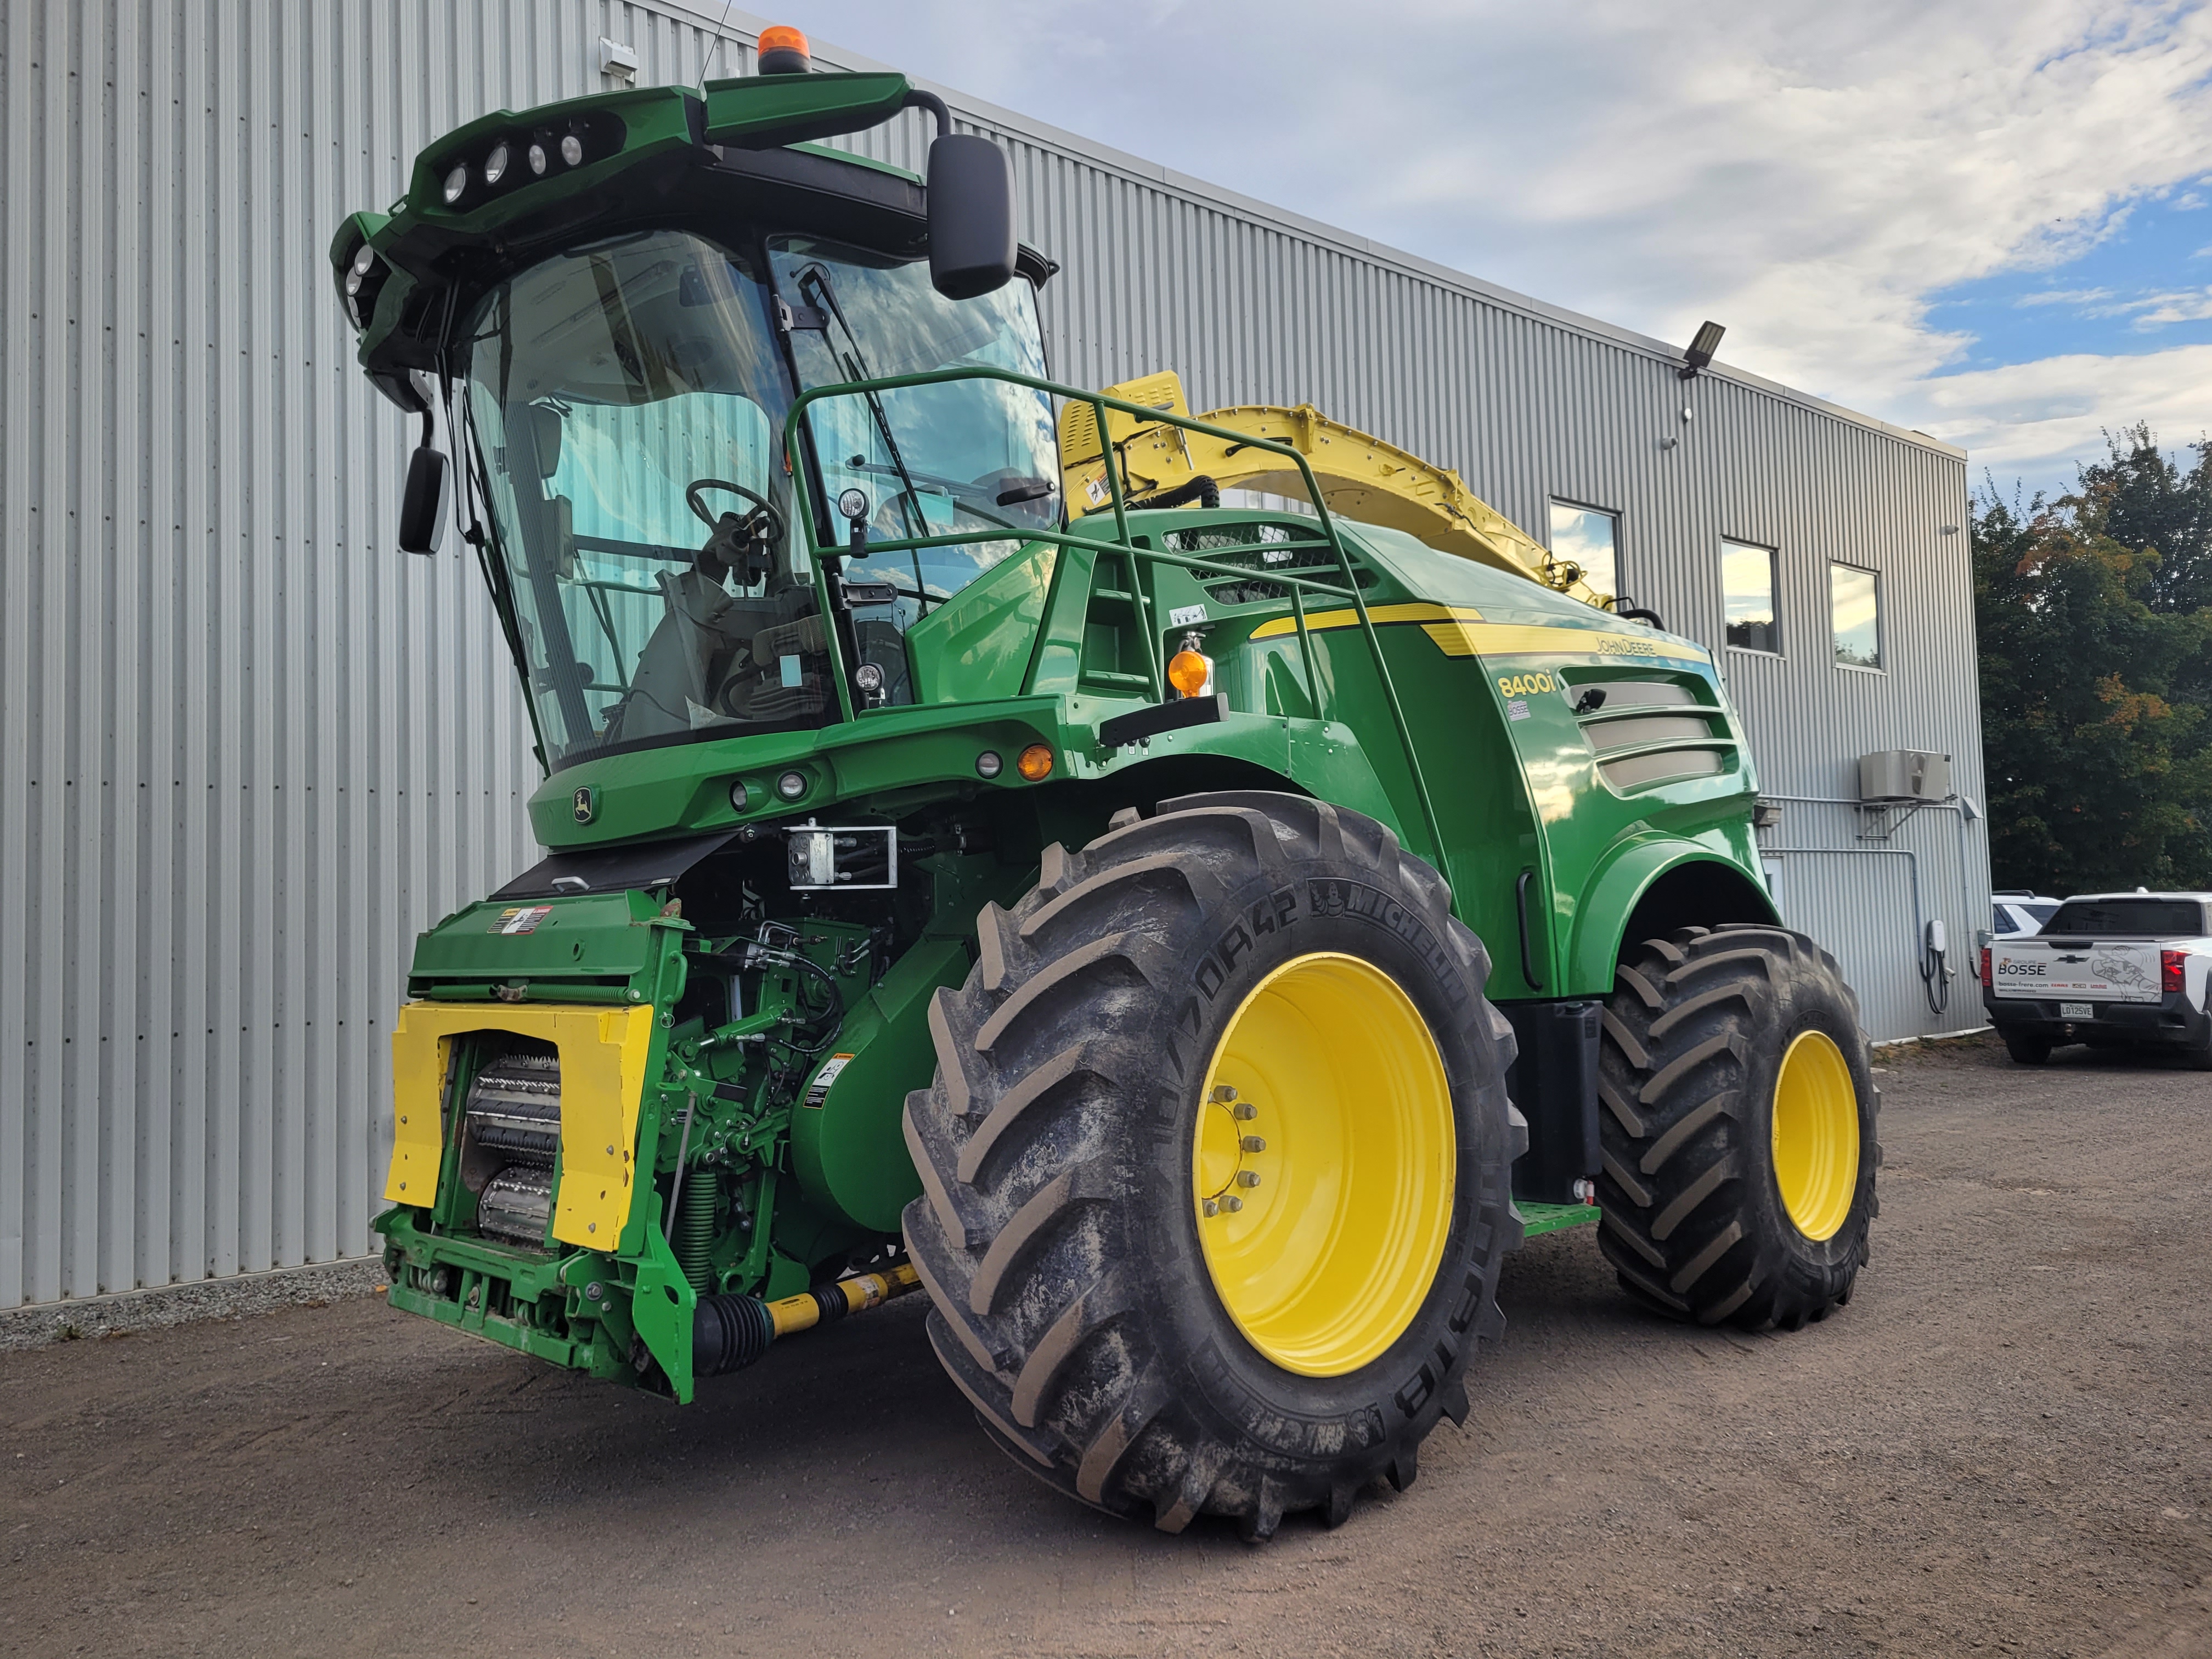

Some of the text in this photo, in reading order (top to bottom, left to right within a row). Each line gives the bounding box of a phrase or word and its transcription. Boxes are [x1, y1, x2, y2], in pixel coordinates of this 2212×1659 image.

[1596, 637, 1656, 655] JOHN DEERE
[1498, 668, 1556, 698] 8400i
[1346, 884, 1468, 1003] MICHELIN
[1998, 964, 2047, 976] BOSSE
